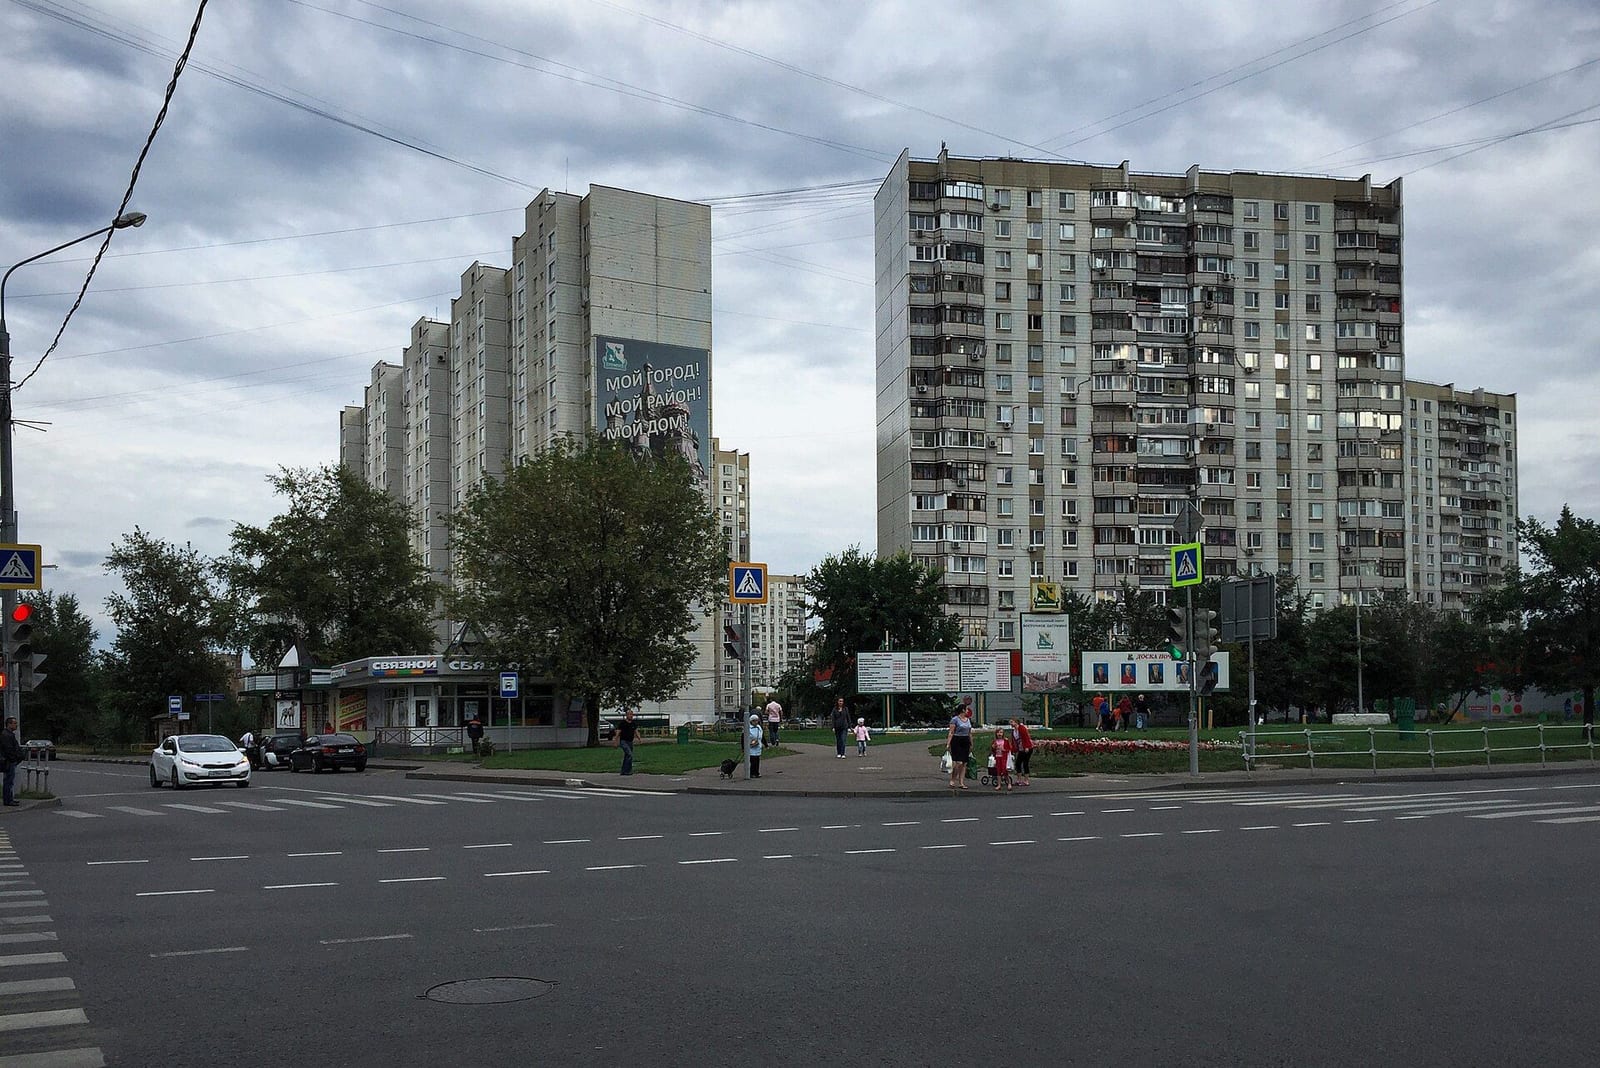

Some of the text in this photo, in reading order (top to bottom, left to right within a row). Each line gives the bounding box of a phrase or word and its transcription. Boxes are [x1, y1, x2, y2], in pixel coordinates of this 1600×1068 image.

[606, 362, 701, 392] МОЙ ГОРОД!
[606, 386, 702, 417] МОЙ РАЙОН!
[606, 413, 688, 440] МОЙ ДОМ!
[372, 656, 437, 670] СВЯЗНОЙ
